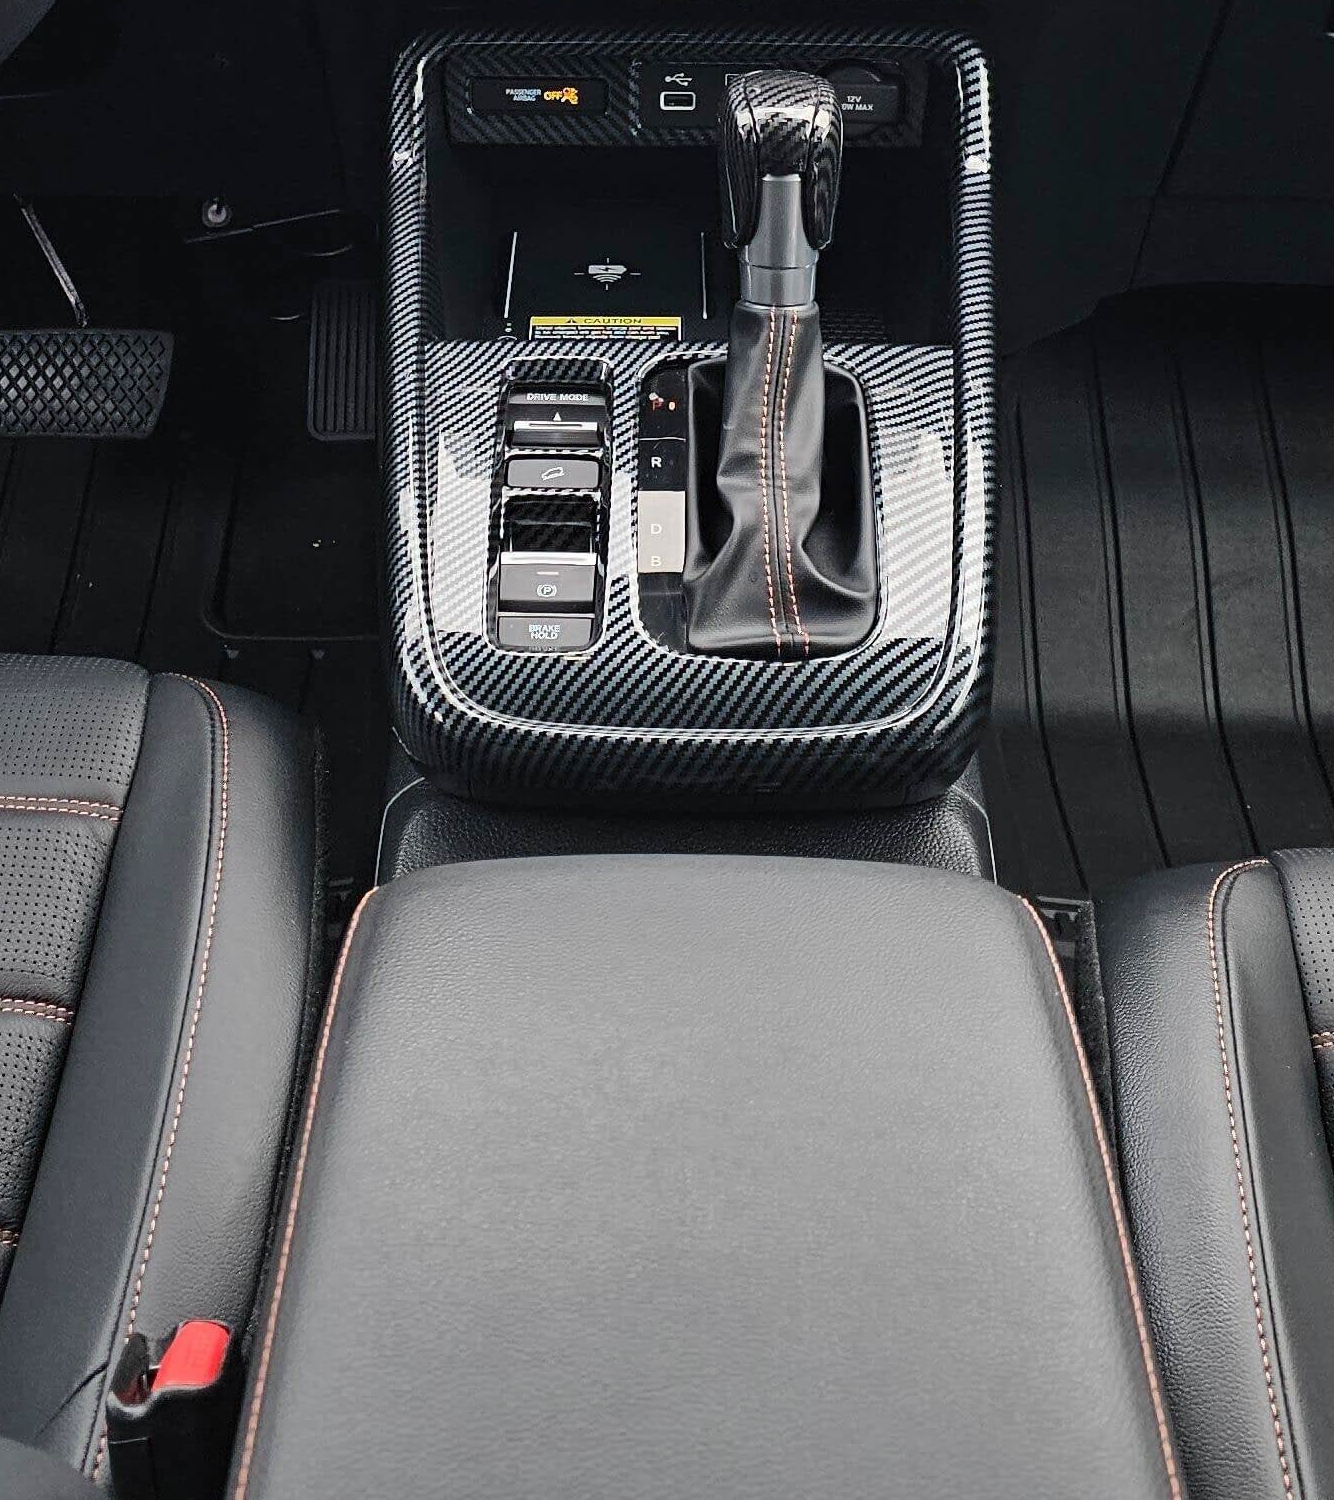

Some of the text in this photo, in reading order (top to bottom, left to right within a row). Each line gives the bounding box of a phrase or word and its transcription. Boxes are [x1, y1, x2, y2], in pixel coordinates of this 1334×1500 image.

[505, 88, 542, 96] PASSENGER
[543, 90, 563, 101] OFF
[512, 94, 537, 102] AIRBAG
[847, 95, 862, 103] 12V
[855, 103, 874, 111] MAX
[526, 393, 589, 402] DRIVE MODE
[651, 456, 662, 468] R
[650, 523, 663, 535] D
[650, 555, 662, 567] B
[528, 624, 561, 633] BRAKE
[530, 631, 558, 640] HOLD
